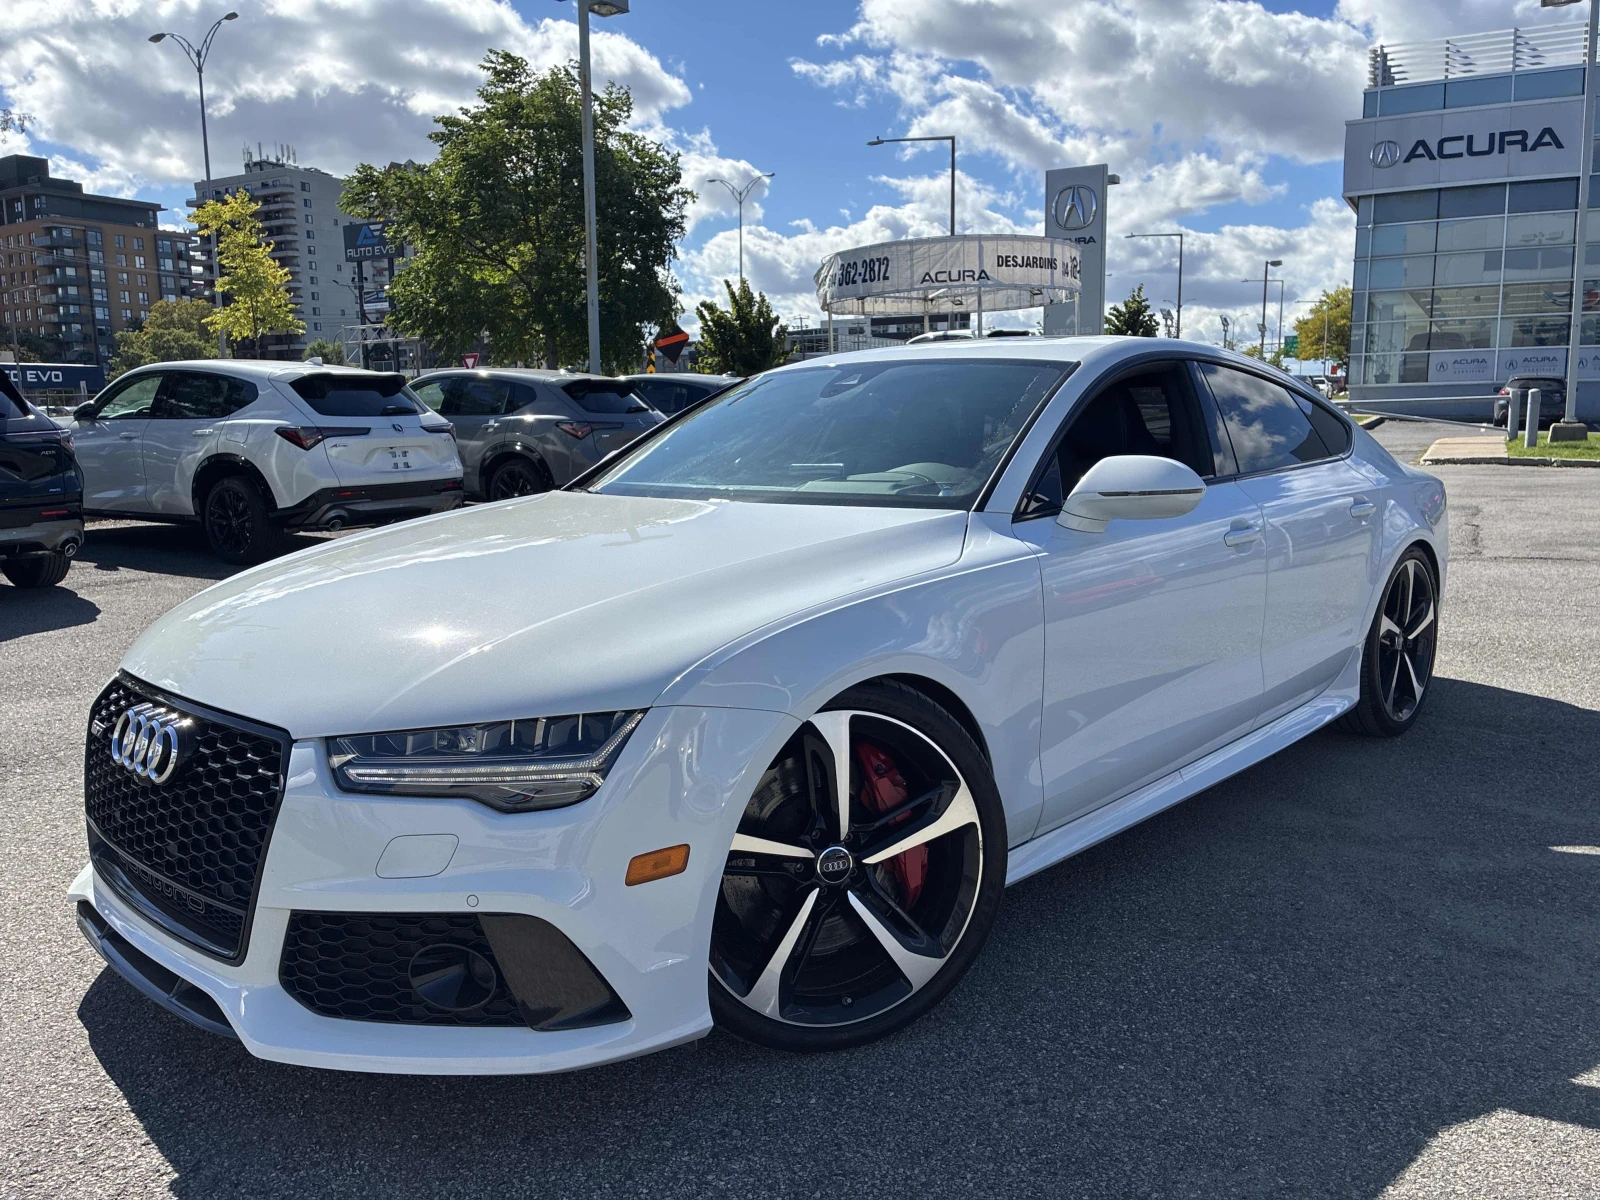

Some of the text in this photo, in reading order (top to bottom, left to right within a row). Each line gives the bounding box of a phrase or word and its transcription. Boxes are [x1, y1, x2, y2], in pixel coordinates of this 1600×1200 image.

[1403, 127, 1564, 163] ACURA
[347, 244, 396, 258] AUTO EVO
[996, 254, 1058, 271] DESJARDINS
[838, 256, 890, 287] 362-2872
[920, 268, 991, 285] ACURA
[26, 370, 63, 382] EVO
